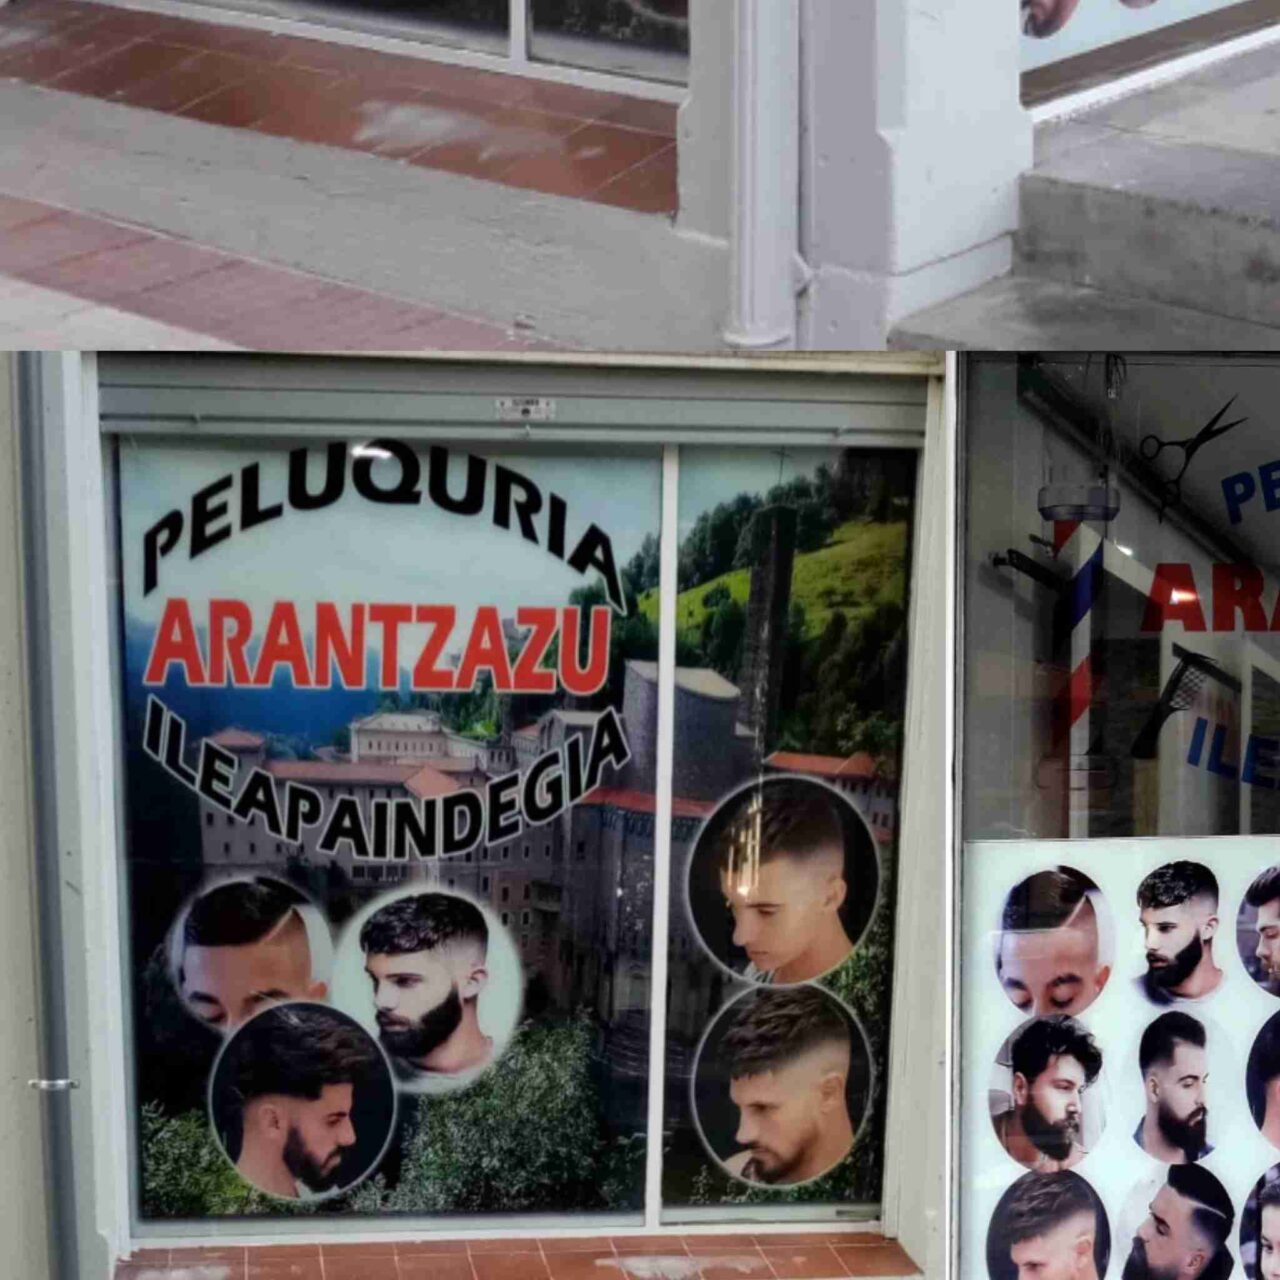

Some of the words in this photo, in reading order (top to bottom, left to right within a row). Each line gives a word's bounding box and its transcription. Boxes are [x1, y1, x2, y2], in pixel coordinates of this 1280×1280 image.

[142, 437, 628, 614] PELUQURIA
[143, 597, 612, 694] ARANTZAZU
[142, 693, 631, 860] ILEAPAINDEGIA
